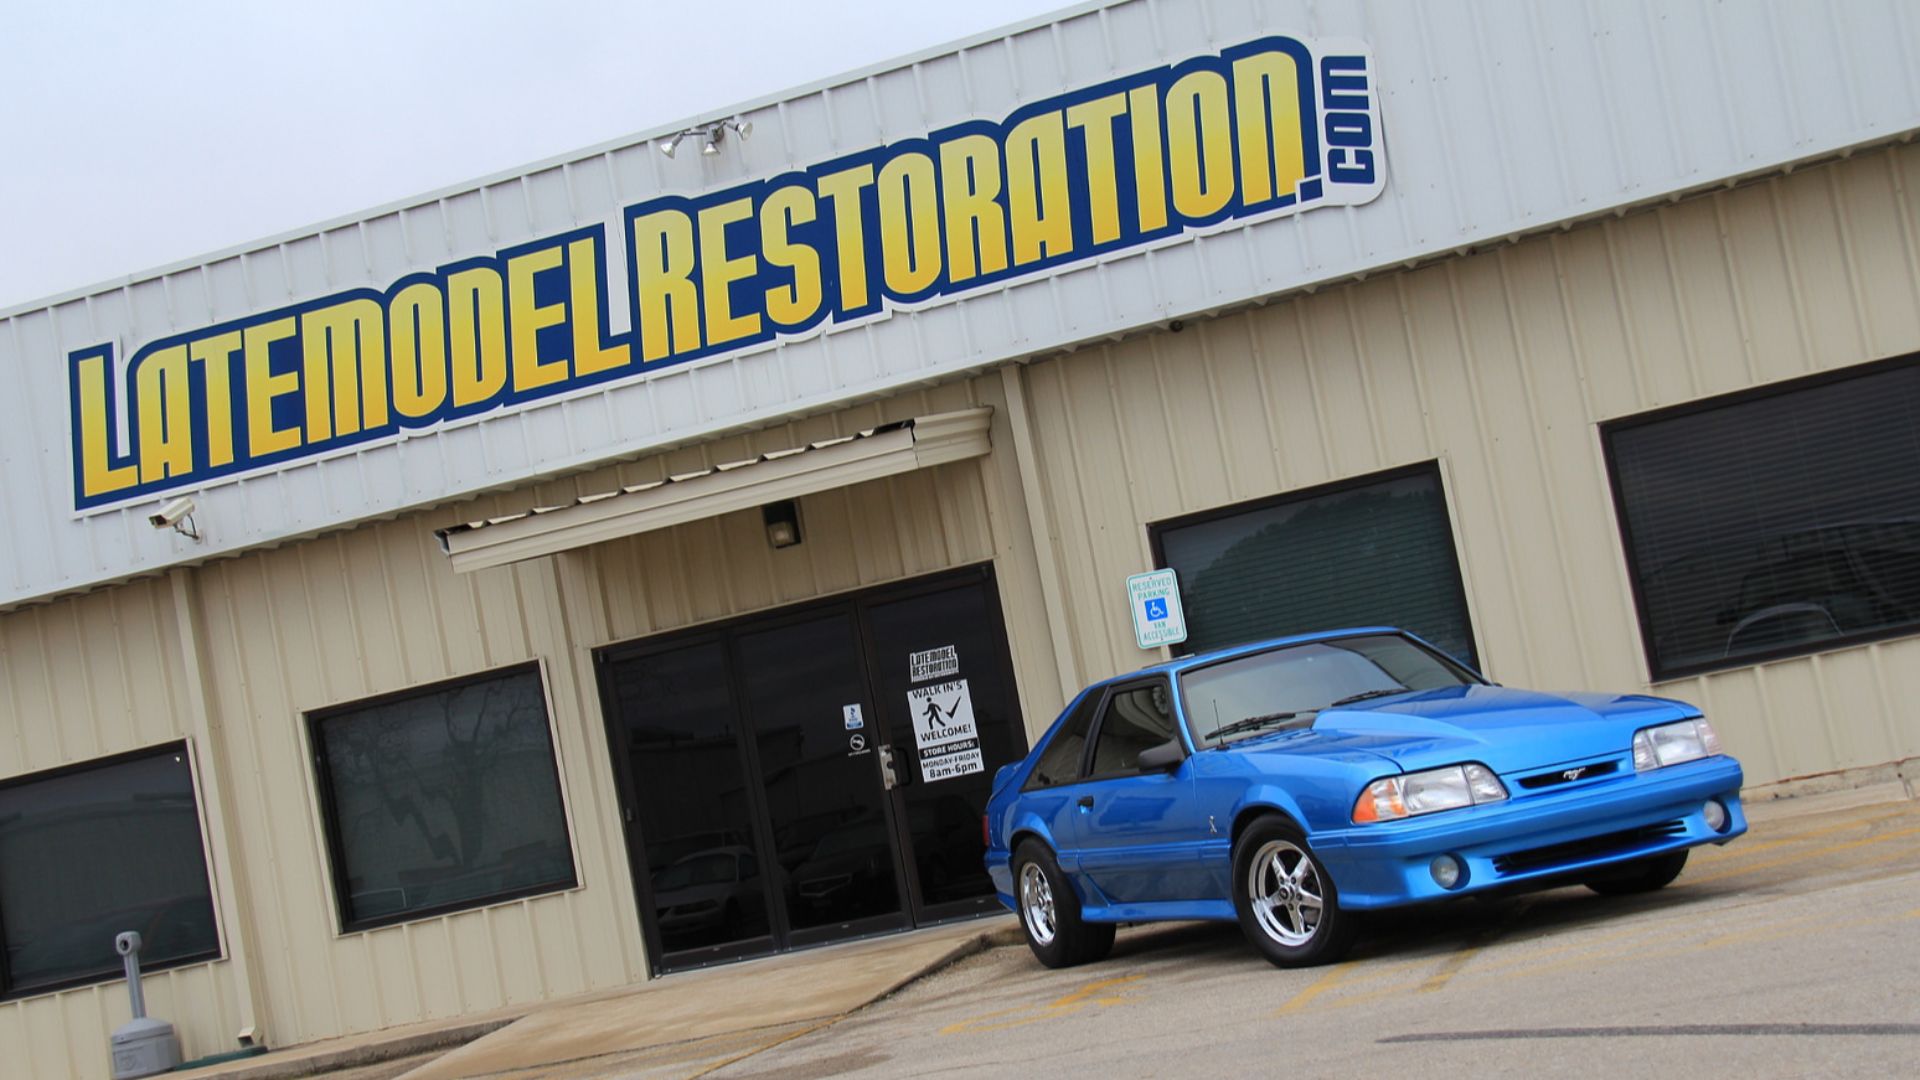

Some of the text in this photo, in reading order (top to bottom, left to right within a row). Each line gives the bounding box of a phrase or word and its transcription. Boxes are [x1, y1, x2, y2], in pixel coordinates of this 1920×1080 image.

[1131, 577, 1172, 592] RESERVED
[1137, 588, 1170, 600] PARKING
[912, 680, 963, 699] WALK IN'S
[920, 723, 972, 743] WELCOME!
[923, 747, 947, 757] STORE
[929, 762, 978, 778] 8am-6pm
